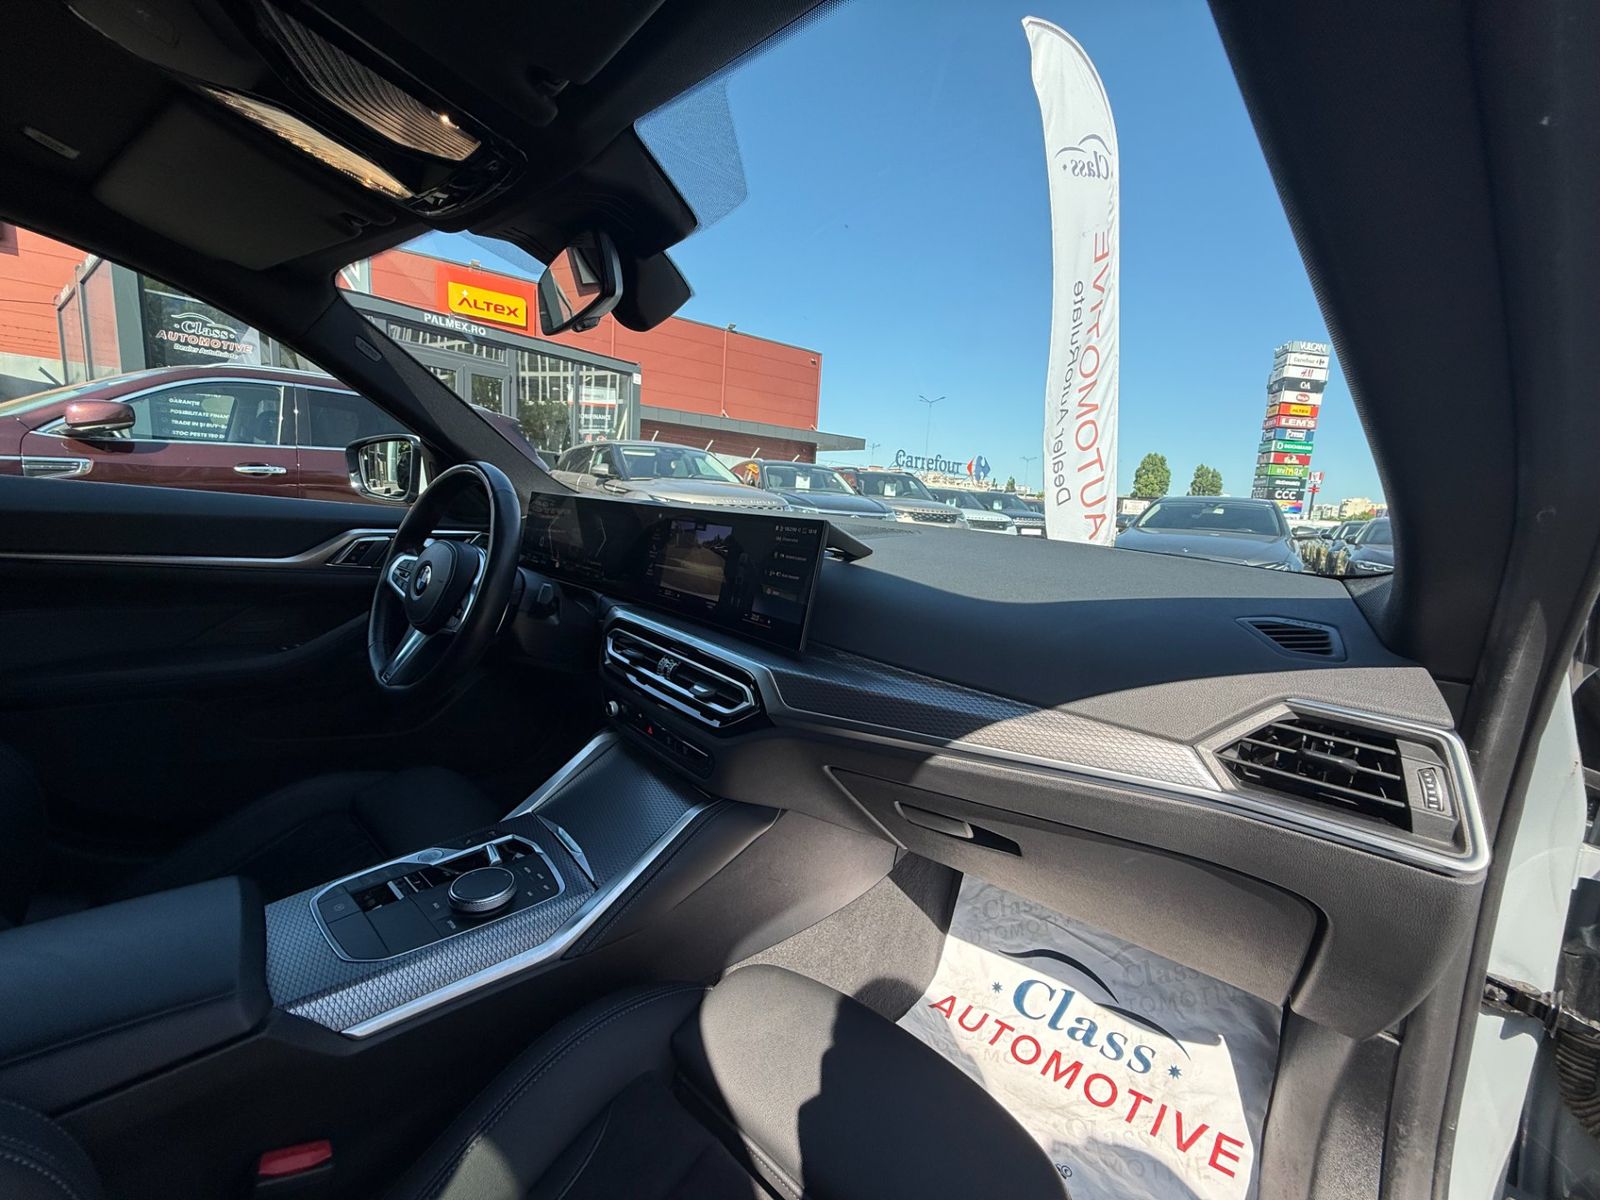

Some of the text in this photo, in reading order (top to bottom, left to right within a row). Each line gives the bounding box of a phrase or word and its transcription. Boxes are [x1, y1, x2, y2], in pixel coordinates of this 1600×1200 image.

[180, 320, 229, 340] Class
[424, 313, 487, 336] PALMEX.RO
[155, 329, 254, 354] AUTOMOTIVE
[1300, 343, 1326, 353] VULCAN
[895, 449, 963, 474] Carrefour
[1275, 490, 1296, 499] CCC
[1013, 978, 1157, 1075] Class
[928, 995, 1245, 1178] AUTOMOTIVE
